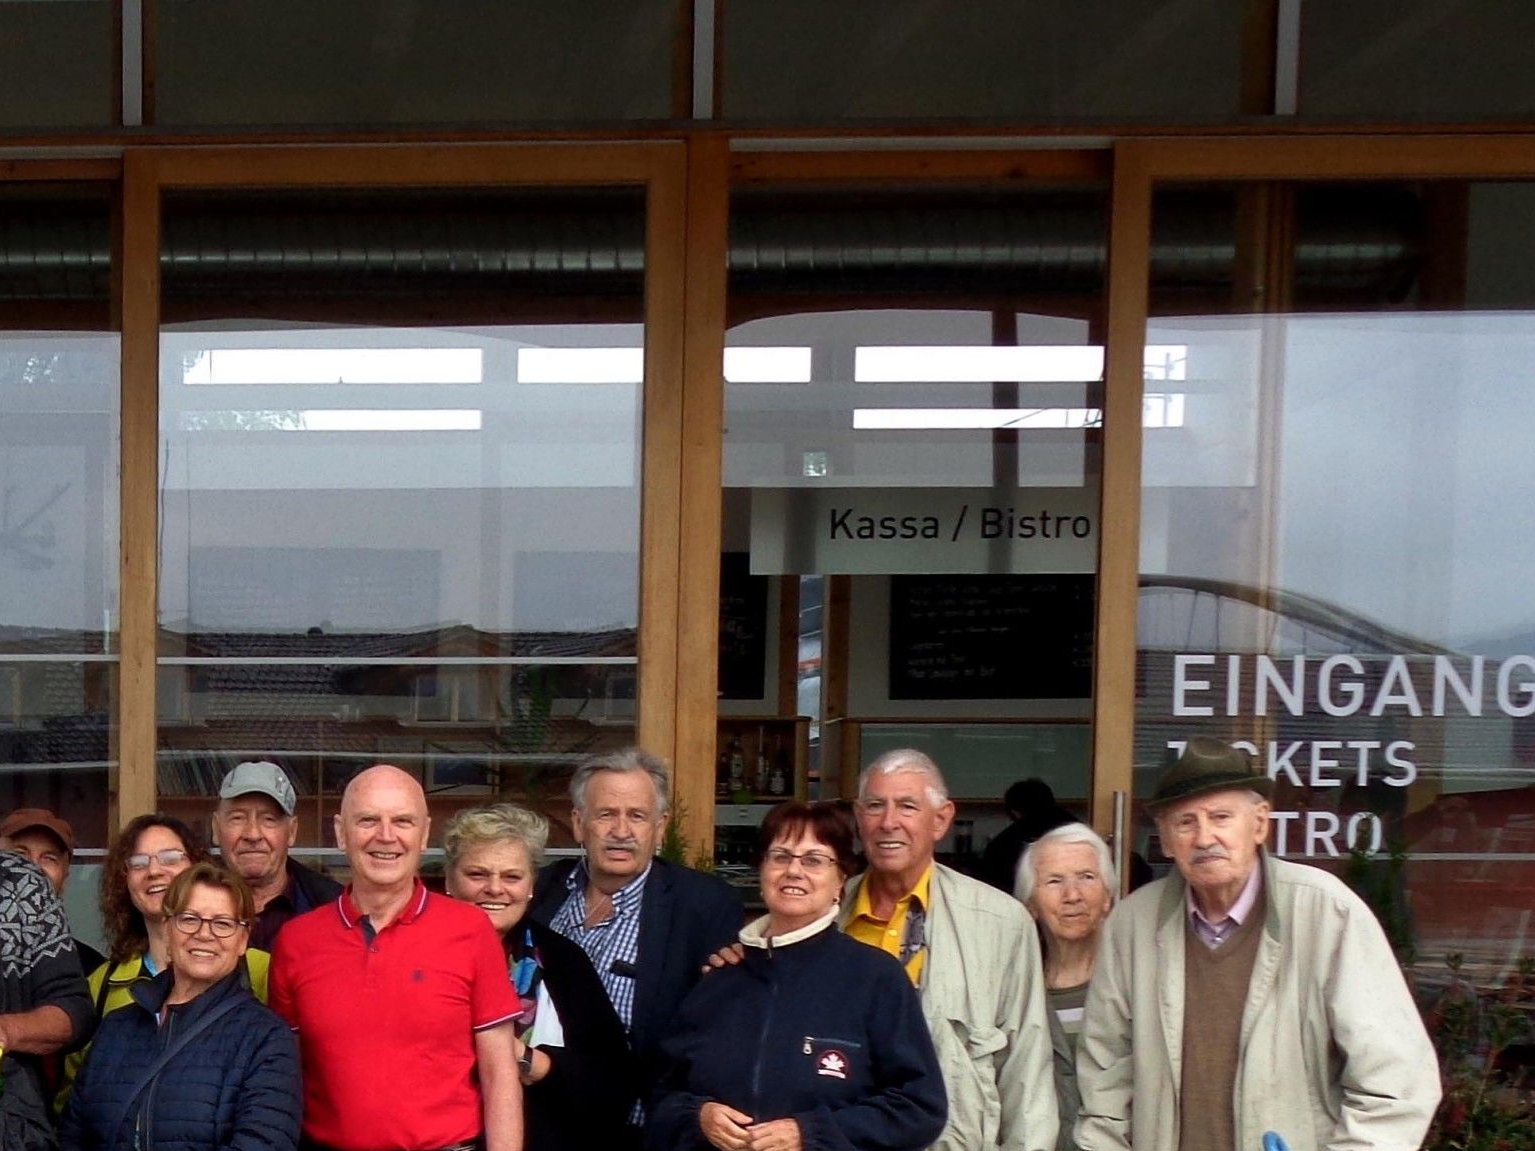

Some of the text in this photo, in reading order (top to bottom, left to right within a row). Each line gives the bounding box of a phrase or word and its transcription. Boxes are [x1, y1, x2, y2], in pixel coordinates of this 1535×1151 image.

[829, 504, 1092, 542] Kassa / Bistro
[1172, 654, 1535, 717] EINGANG
[1167, 740, 1417, 788] KETS
[1267, 810, 1383, 858] TRO
